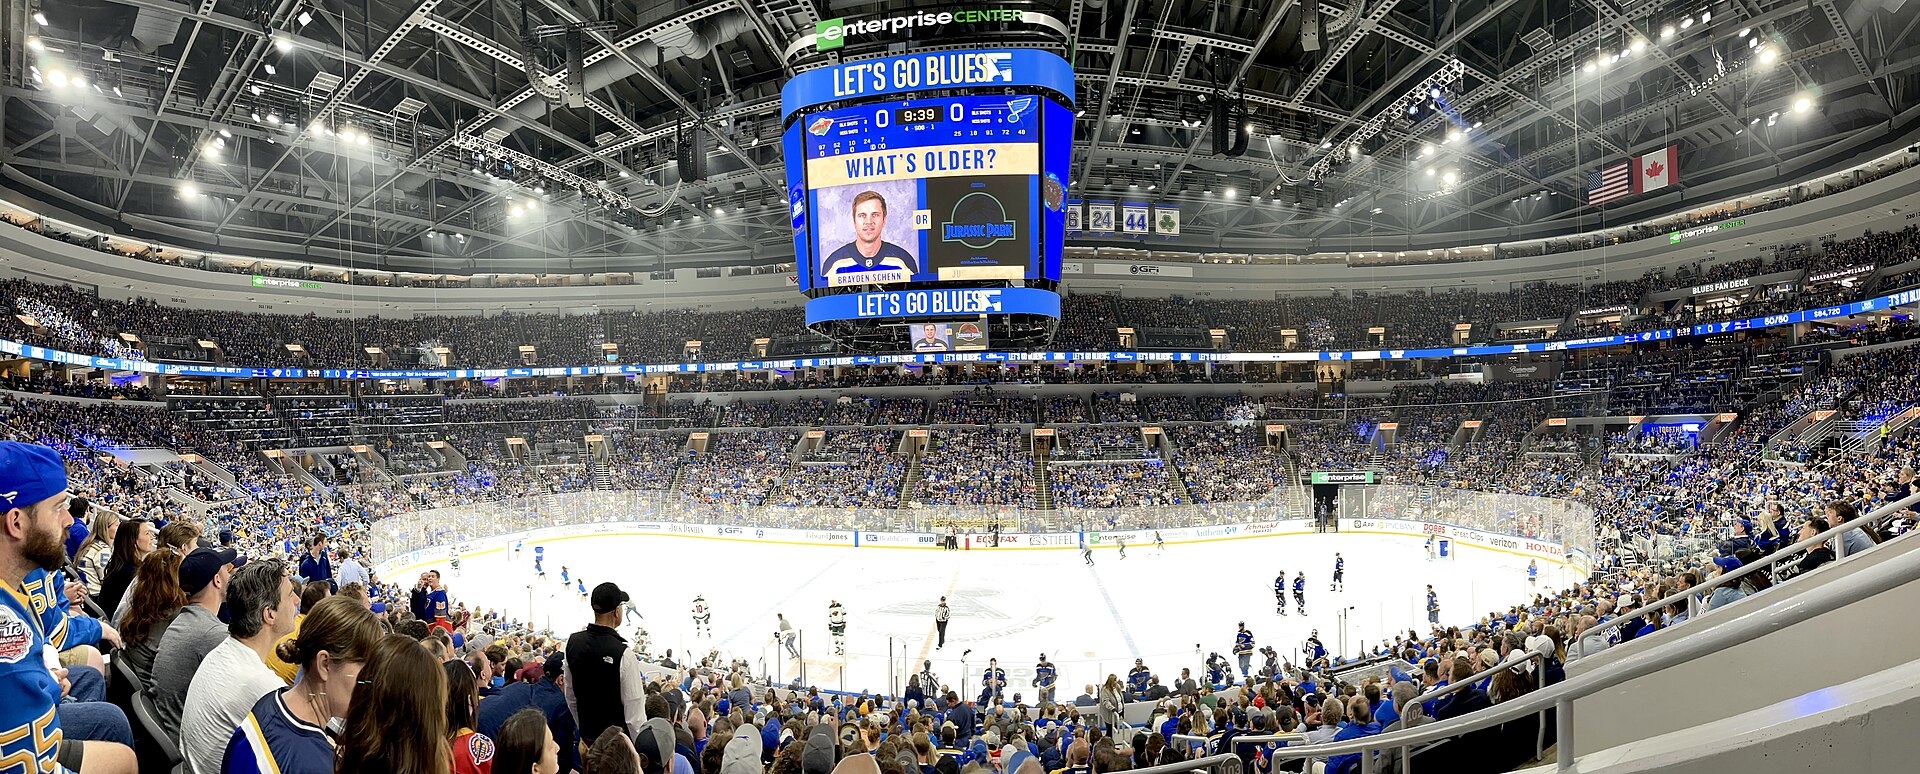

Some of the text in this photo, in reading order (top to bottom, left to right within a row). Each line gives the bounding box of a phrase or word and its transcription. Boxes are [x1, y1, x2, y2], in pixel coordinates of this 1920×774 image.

[817, 9, 1023, 40] enterprise CENTER
[833, 53, 988, 97] LET'S GO BLUES
[875, 109, 889, 128] 0
[904, 109, 935, 122] 9:39
[950, 103, 964, 122] 0
[846, 149, 997, 178] WHAT'S OLDER?
[915, 214, 928, 225] OR
[1093, 211, 1111, 228] 24
[1125, 214, 1147, 231] 44
[944, 223, 1013, 239] JURASSIC PARK
[1670, 225, 1718, 240] enterprise
[253, 278, 299, 288] enterprise
[837, 272, 901, 284] BRAYDEN SCHENN
[1692, 279, 1749, 295] BLUES FAN DECK
[857, 290, 982, 317] LET'S GO BLUES
[1764, 315, 1789, 325] 50/50
[1813, 308, 1840, 318] $84,720
[1319, 474, 1365, 482] enterprise
[1194, 528, 1224, 538] Anthem
[1423, 523, 1446, 534] DOBBS
[1452, 528, 1484, 542] Great Clips
[806, 532, 848, 541] Edward Jones
[1042, 535, 1075, 545] STIFEL
[1490, 538, 1517, 549] verizon
[1526, 542, 1563, 556] HONDA
[695, 604, 703, 613] 10
[1407, 708, 1423, 722] 102
[0, 705, 63, 774] 55
[1222, 763, 1240, 774] 103
